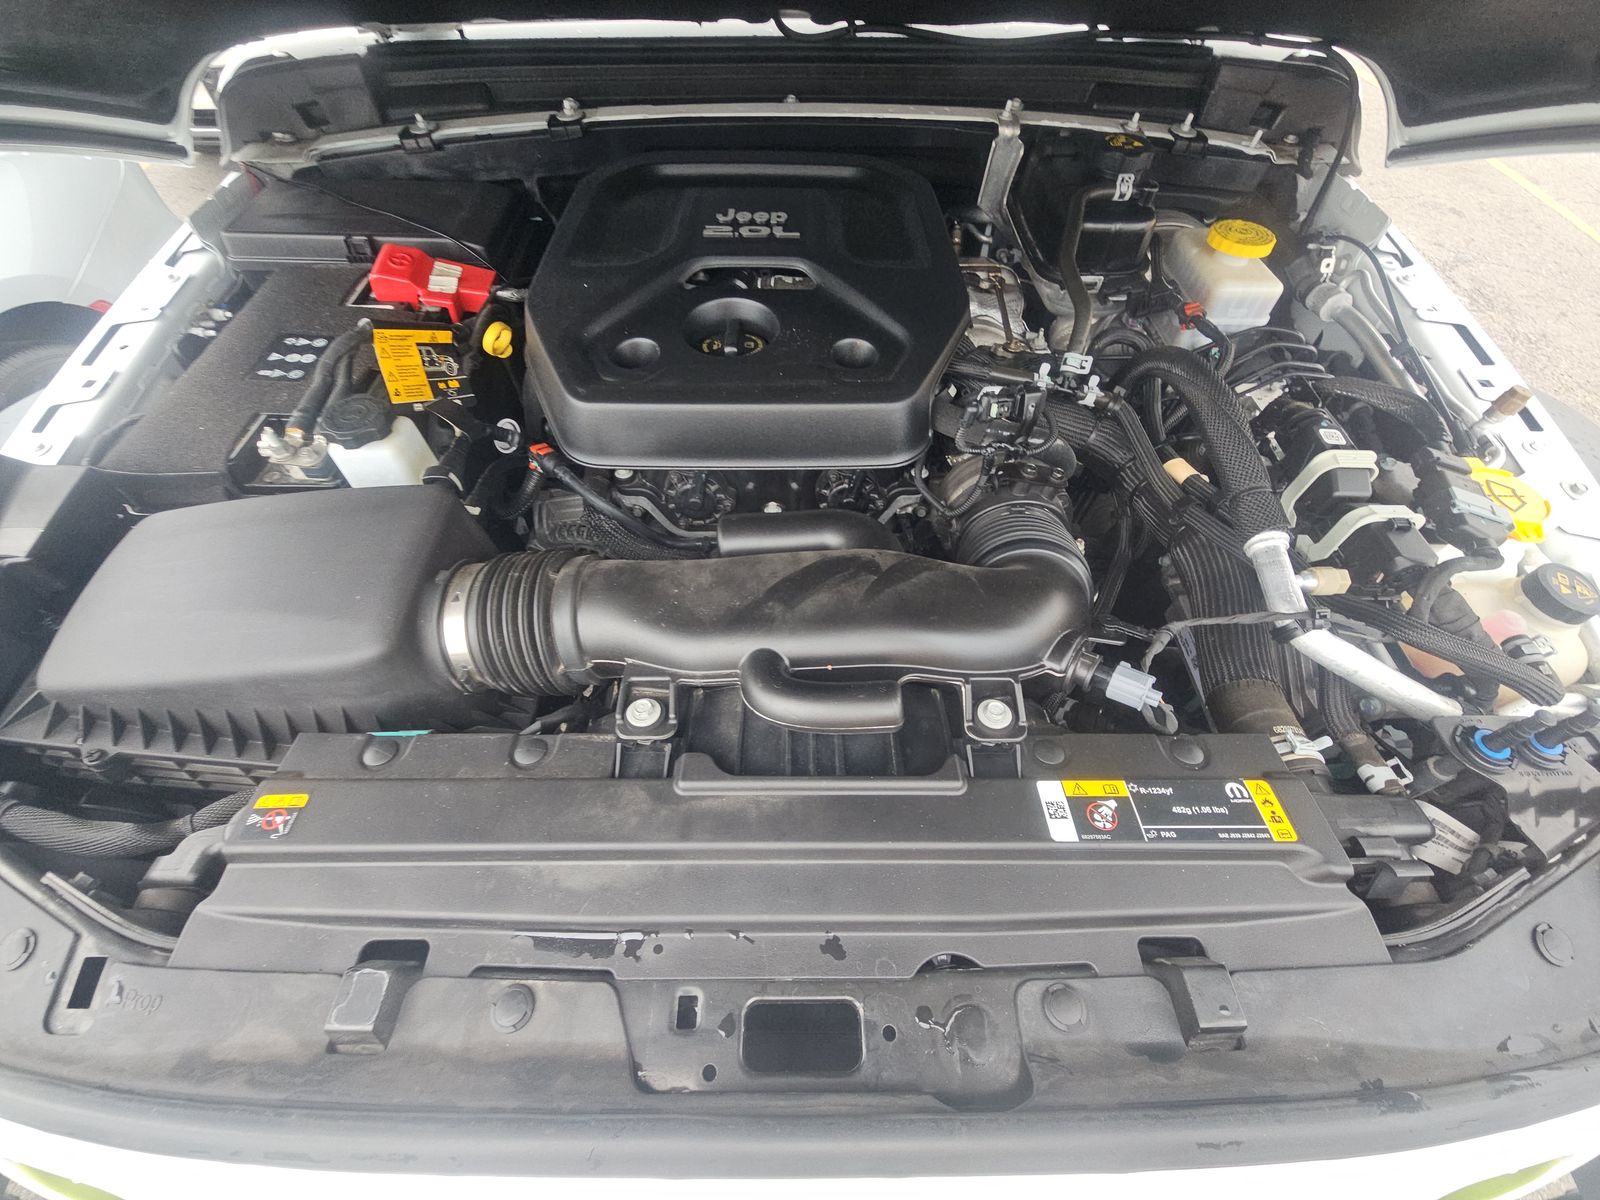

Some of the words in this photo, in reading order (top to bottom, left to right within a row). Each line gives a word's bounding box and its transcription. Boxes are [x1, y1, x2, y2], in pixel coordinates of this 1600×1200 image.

[715, 208, 788, 224] Jeep
[702, 225, 801, 238] 2.0L
[1138, 787, 1174, 796] R-1234yf
